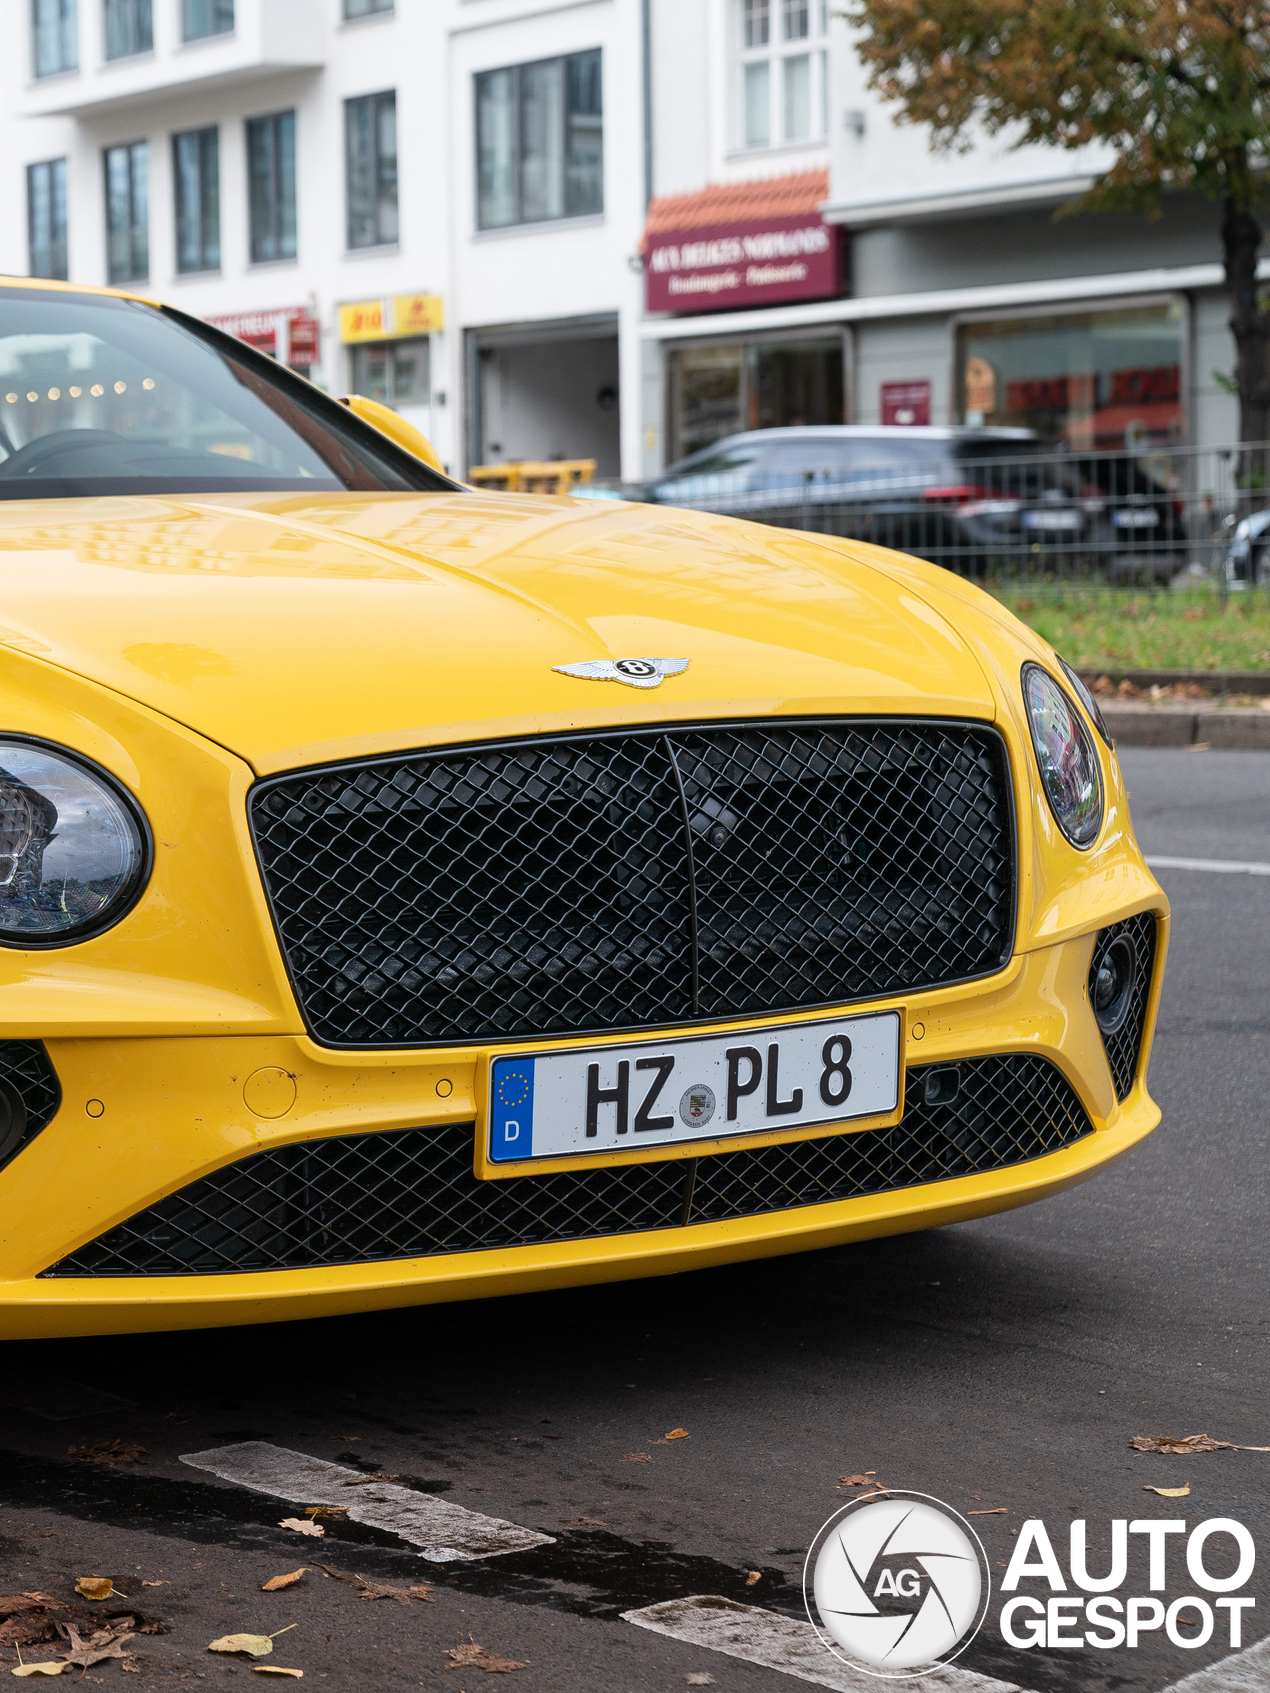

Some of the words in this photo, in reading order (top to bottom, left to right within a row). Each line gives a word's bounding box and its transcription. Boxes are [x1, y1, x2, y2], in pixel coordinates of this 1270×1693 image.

[622, 660, 648, 675] B
[585, 1055, 676, 1138] HZ
[725, 1043, 803, 1121] PL
[818, 1033, 853, 1107] 8
[504, 1120, 520, 1143] D
